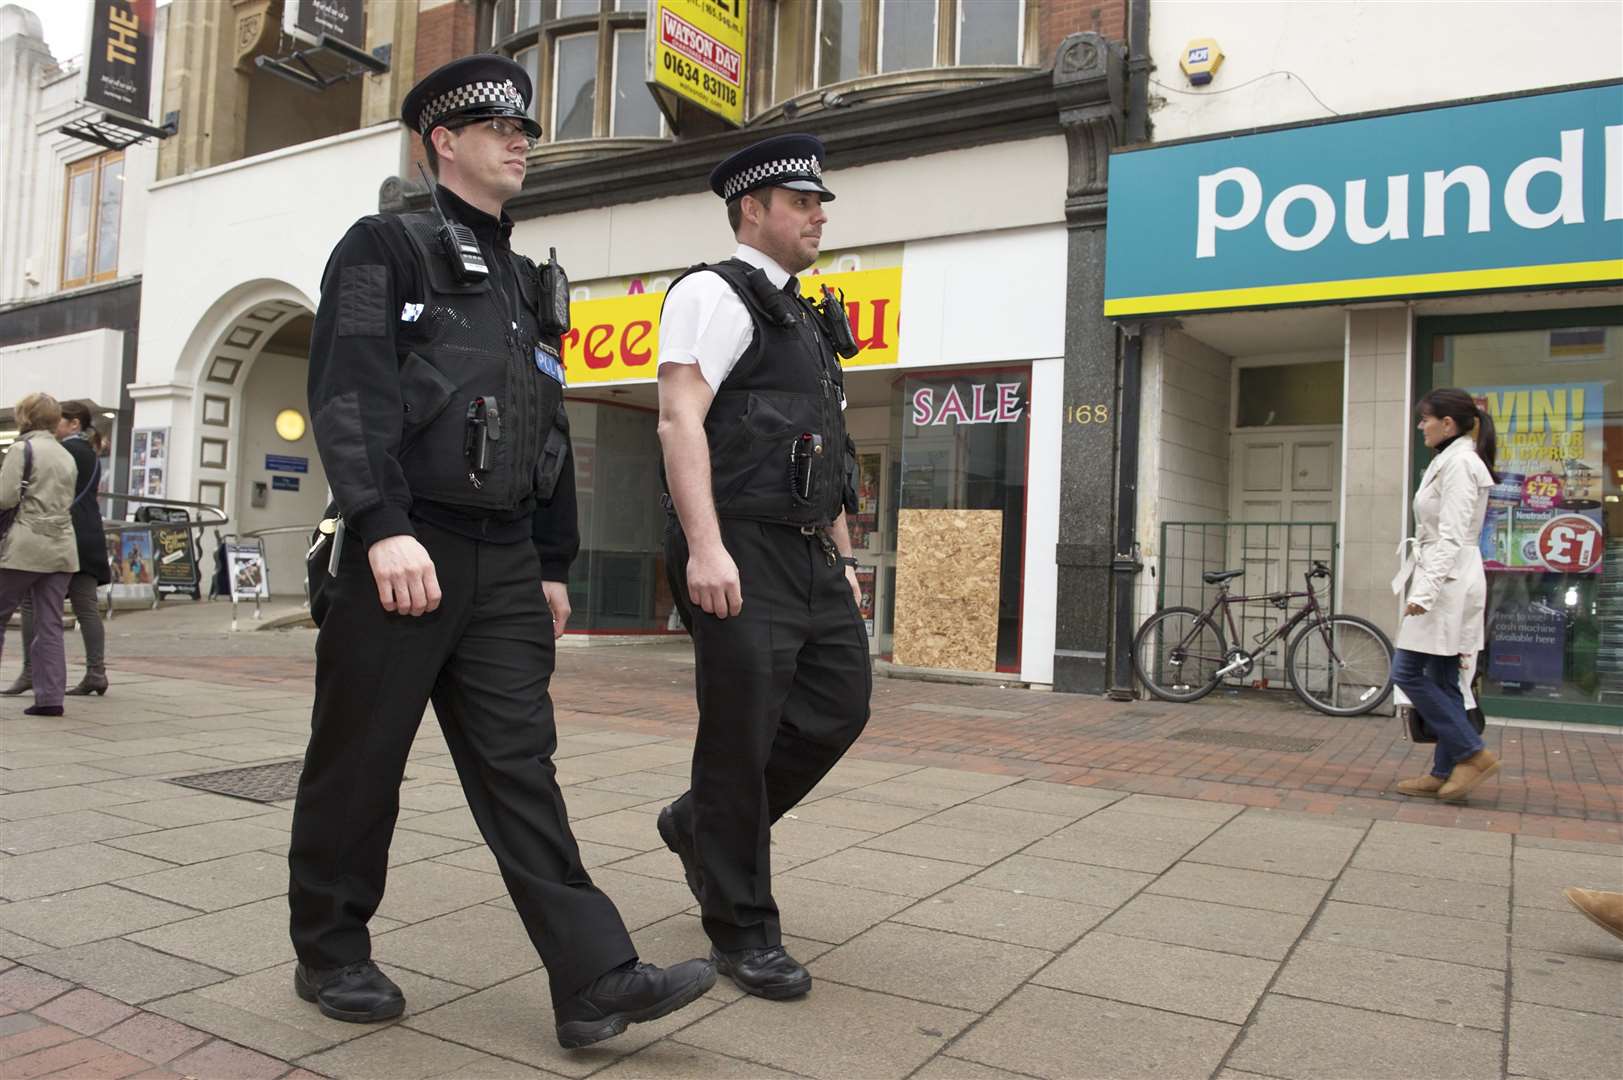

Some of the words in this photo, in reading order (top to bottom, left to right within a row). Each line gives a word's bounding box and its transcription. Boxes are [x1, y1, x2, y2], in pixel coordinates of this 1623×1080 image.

[106, 5, 139, 65] THE
[664, 15, 714, 60] WATSON
[715, 46, 738, 74] DAY
[664, 51, 700, 86] 01634
[703, 72, 737, 107] 831118
[560, 320, 652, 371] ree
[912, 381, 1023, 426] SALE
[1067, 405, 1109, 424] 168
[1526, 481, 1558, 497] £75
[1546, 526, 1596, 566] £1
